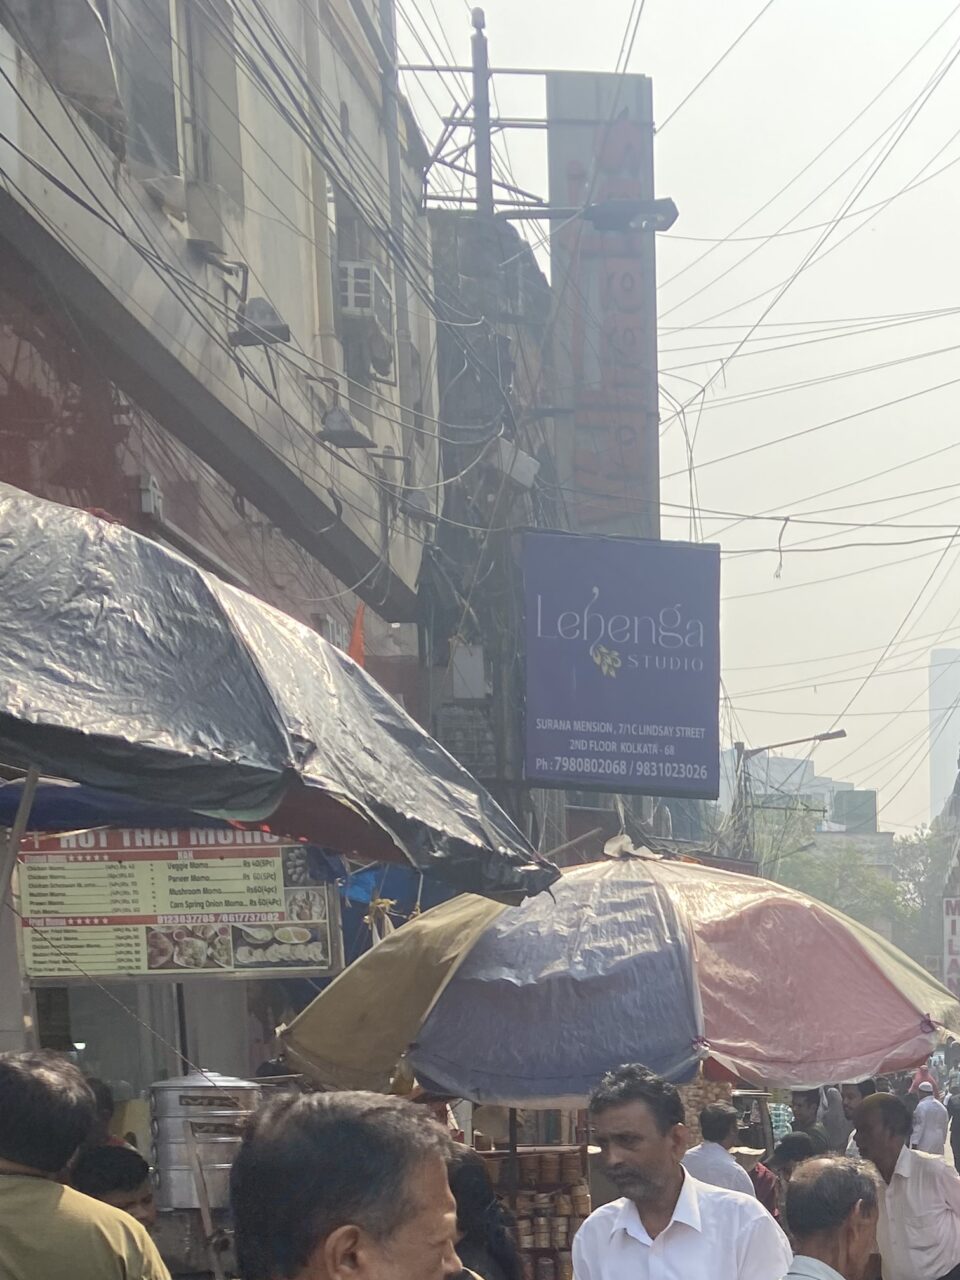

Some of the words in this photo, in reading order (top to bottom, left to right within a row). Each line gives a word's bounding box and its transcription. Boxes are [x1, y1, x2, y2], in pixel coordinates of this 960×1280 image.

[537, 584, 704, 657] Lehenga
[627, 654, 704, 671] STUDIO
[536, 717, 571, 732] SURANA
[638, 723, 674, 737] LINDSAY
[675, 726, 706, 739] STREET
[569, 739, 588, 751] 2ND
[589, 740, 617, 753] FLOOR
[620, 741, 658, 754] KOLKATA
[636, 761, 708, 780] 9831023026
[185, 900, 204, 910] Spring
